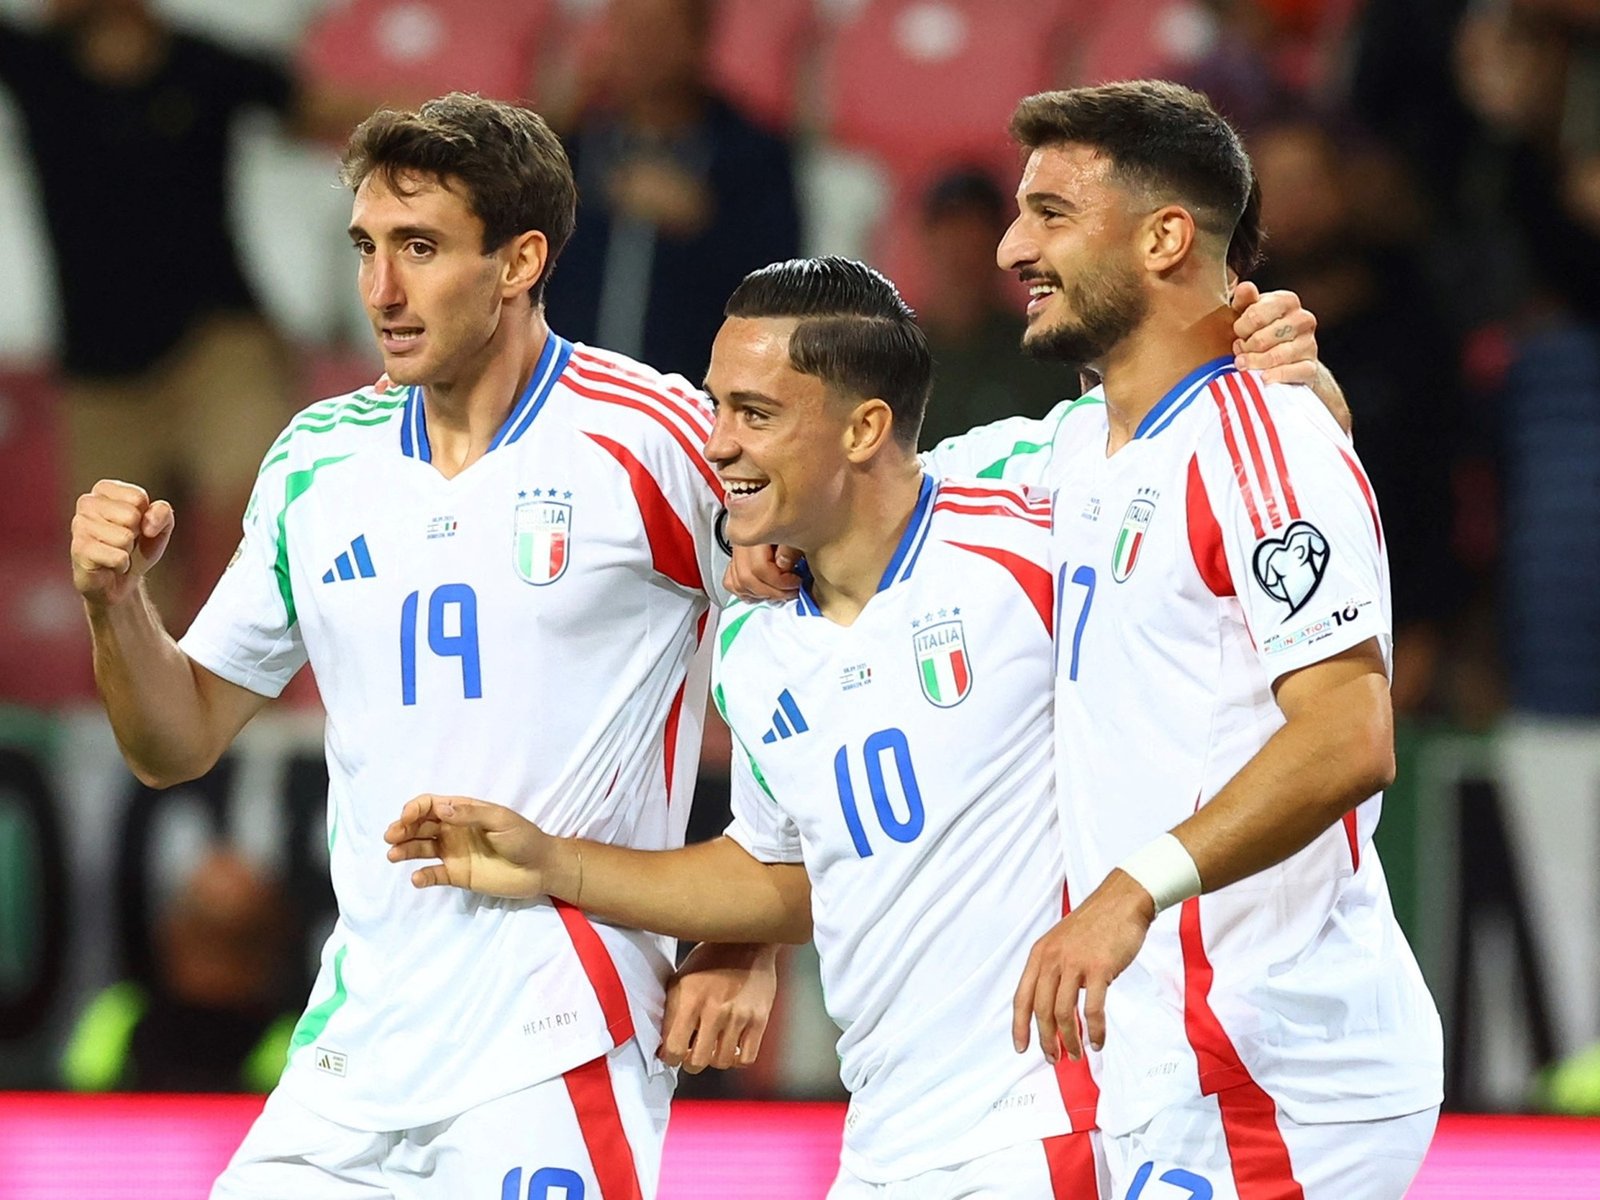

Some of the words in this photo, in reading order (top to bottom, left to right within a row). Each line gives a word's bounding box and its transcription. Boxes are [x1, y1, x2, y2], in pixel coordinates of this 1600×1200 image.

[1126, 505, 1151, 524] ITALIA
[400, 583, 482, 706] 19
[917, 627, 961, 653] ITALIA
[1055, 561, 1096, 682] 17
[834, 727, 926, 858] 10
